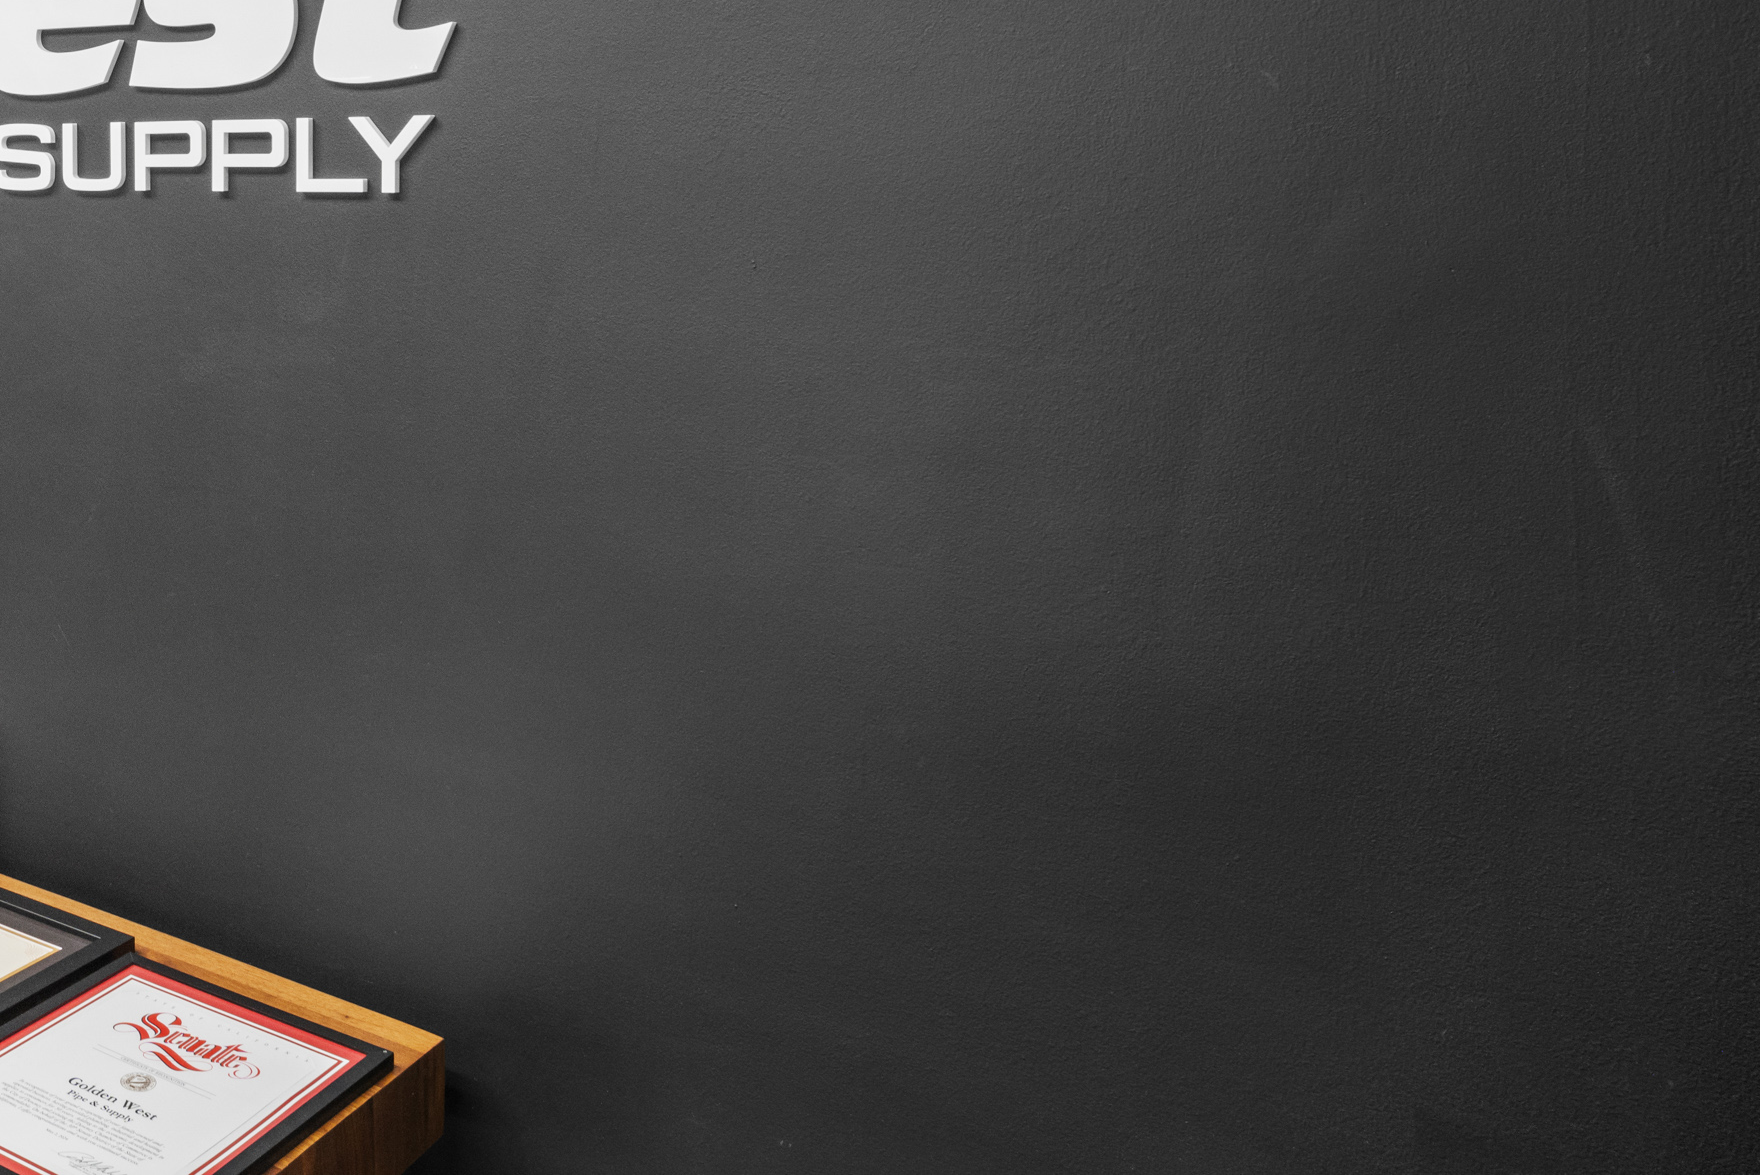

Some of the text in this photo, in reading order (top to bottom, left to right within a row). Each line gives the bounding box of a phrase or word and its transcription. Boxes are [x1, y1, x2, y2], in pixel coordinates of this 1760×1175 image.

[113, 1012, 261, 1079] Senate
[67, 1089, 88, 1103] Pipe
[100, 1104, 133, 1122] Supply
[68, 1077, 158, 1121] Golden West
